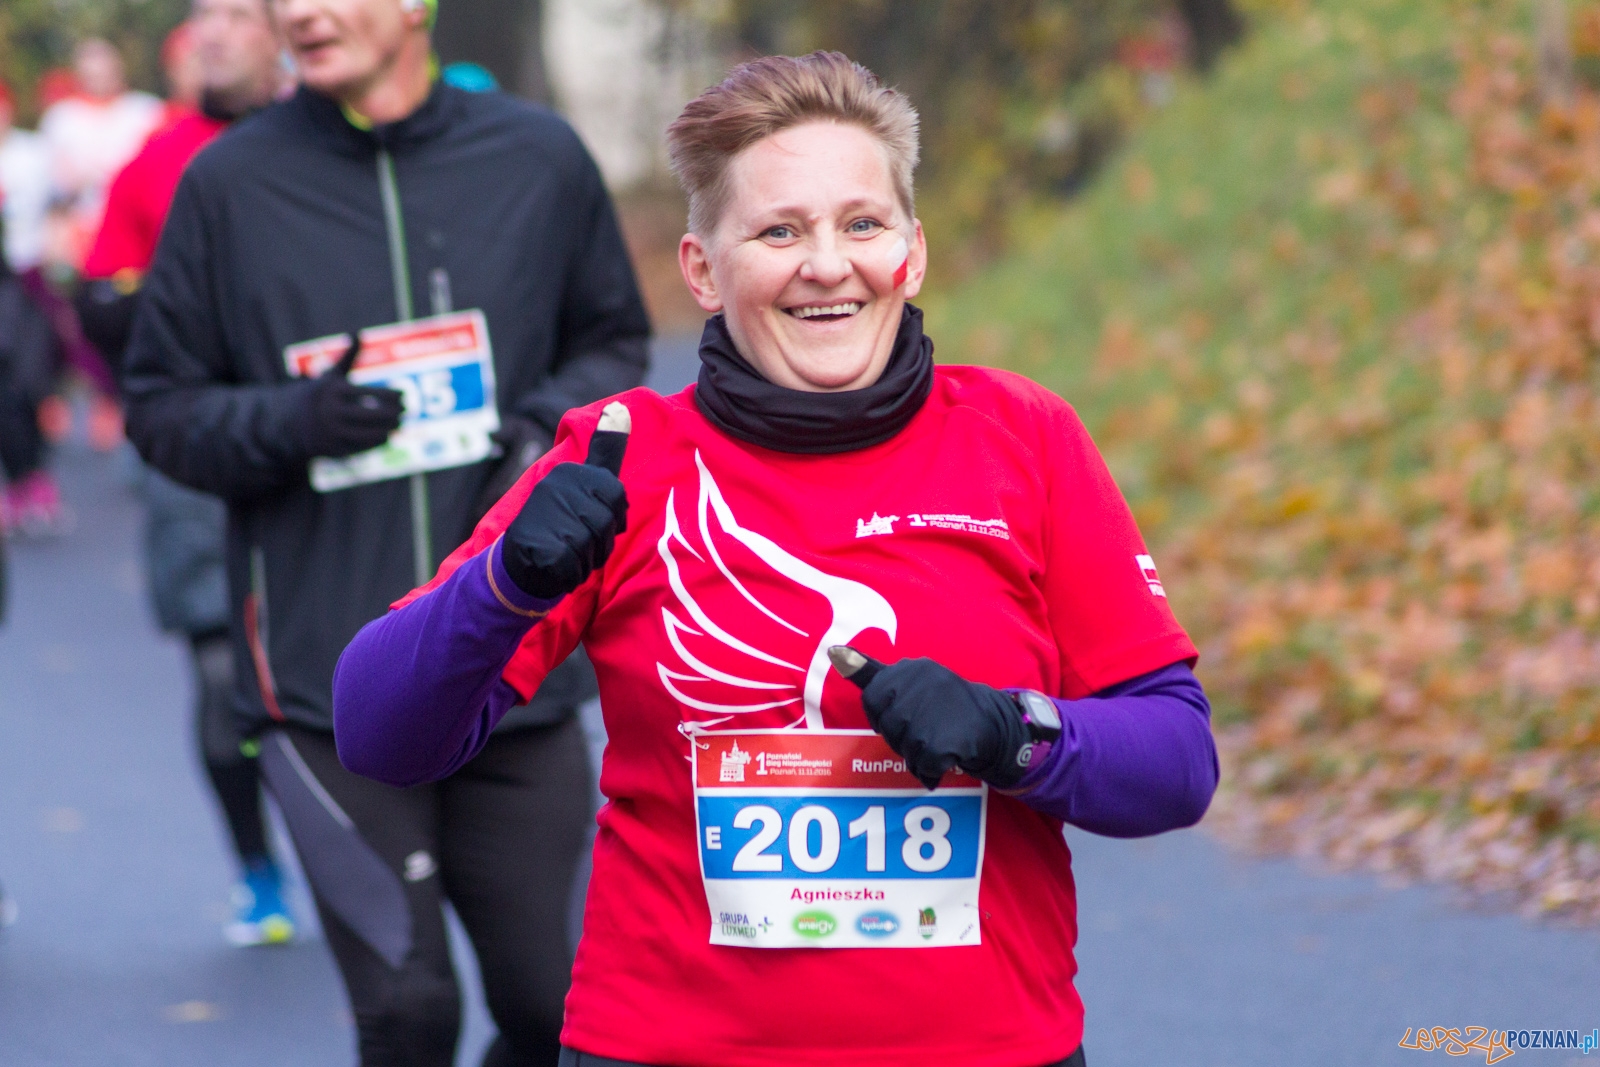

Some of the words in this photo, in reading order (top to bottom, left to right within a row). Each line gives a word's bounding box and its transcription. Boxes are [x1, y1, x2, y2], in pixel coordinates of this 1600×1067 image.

[907, 513, 927, 527] 1
[755, 751, 768, 775] 1
[705, 826, 721, 850] E
[732, 805, 952, 873] 2018
[790, 887, 885, 904] Agnieszka
[719, 912, 749, 925] GRUPA
